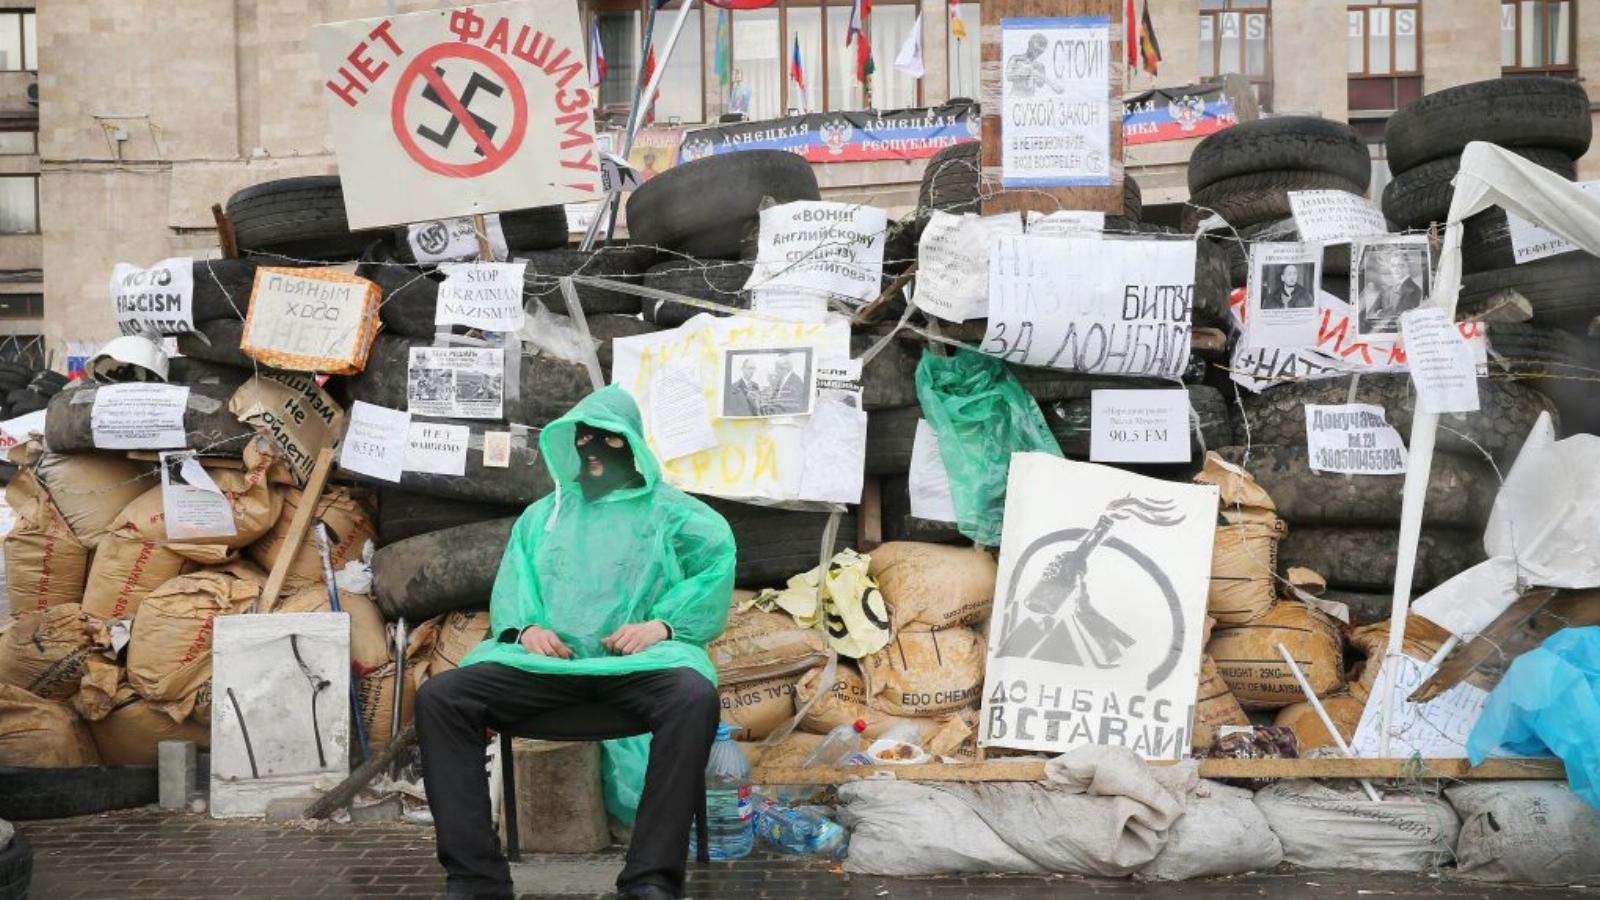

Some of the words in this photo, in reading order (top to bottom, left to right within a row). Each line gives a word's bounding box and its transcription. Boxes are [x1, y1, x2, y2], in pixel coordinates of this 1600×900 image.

[1053, 31, 1104, 79] СТОЙ!
[326, 20, 404, 108] НЕТ
[449, 7, 599, 193] ФАШИЗМУ!
[1013, 99, 1055, 127] СУХОЙ
[1059, 102, 1099, 126] ЗАКОН
[863, 114, 957, 133] ДОНЕЦКАЯ
[721, 123, 809, 147] ДОНЕЦКАЯ
[861, 135, 958, 152] РЕСПУБЛИКА
[122, 271, 147, 287] NO
[148, 268, 172, 287] TO
[467, 269, 499, 283] STOP
[268, 276, 351, 301] ПЬЯНЫМ
[440, 287, 519, 301] UKRAINIAN
[116, 293, 181, 313] FASCISM
[984, 321, 1034, 364] ЗА
[1108, 429, 1140, 442] 90.5
[1144, 429, 1169, 442] FM
[902, 694, 931, 706] EDO
[988, 679, 1173, 723] ДОНБАСС
